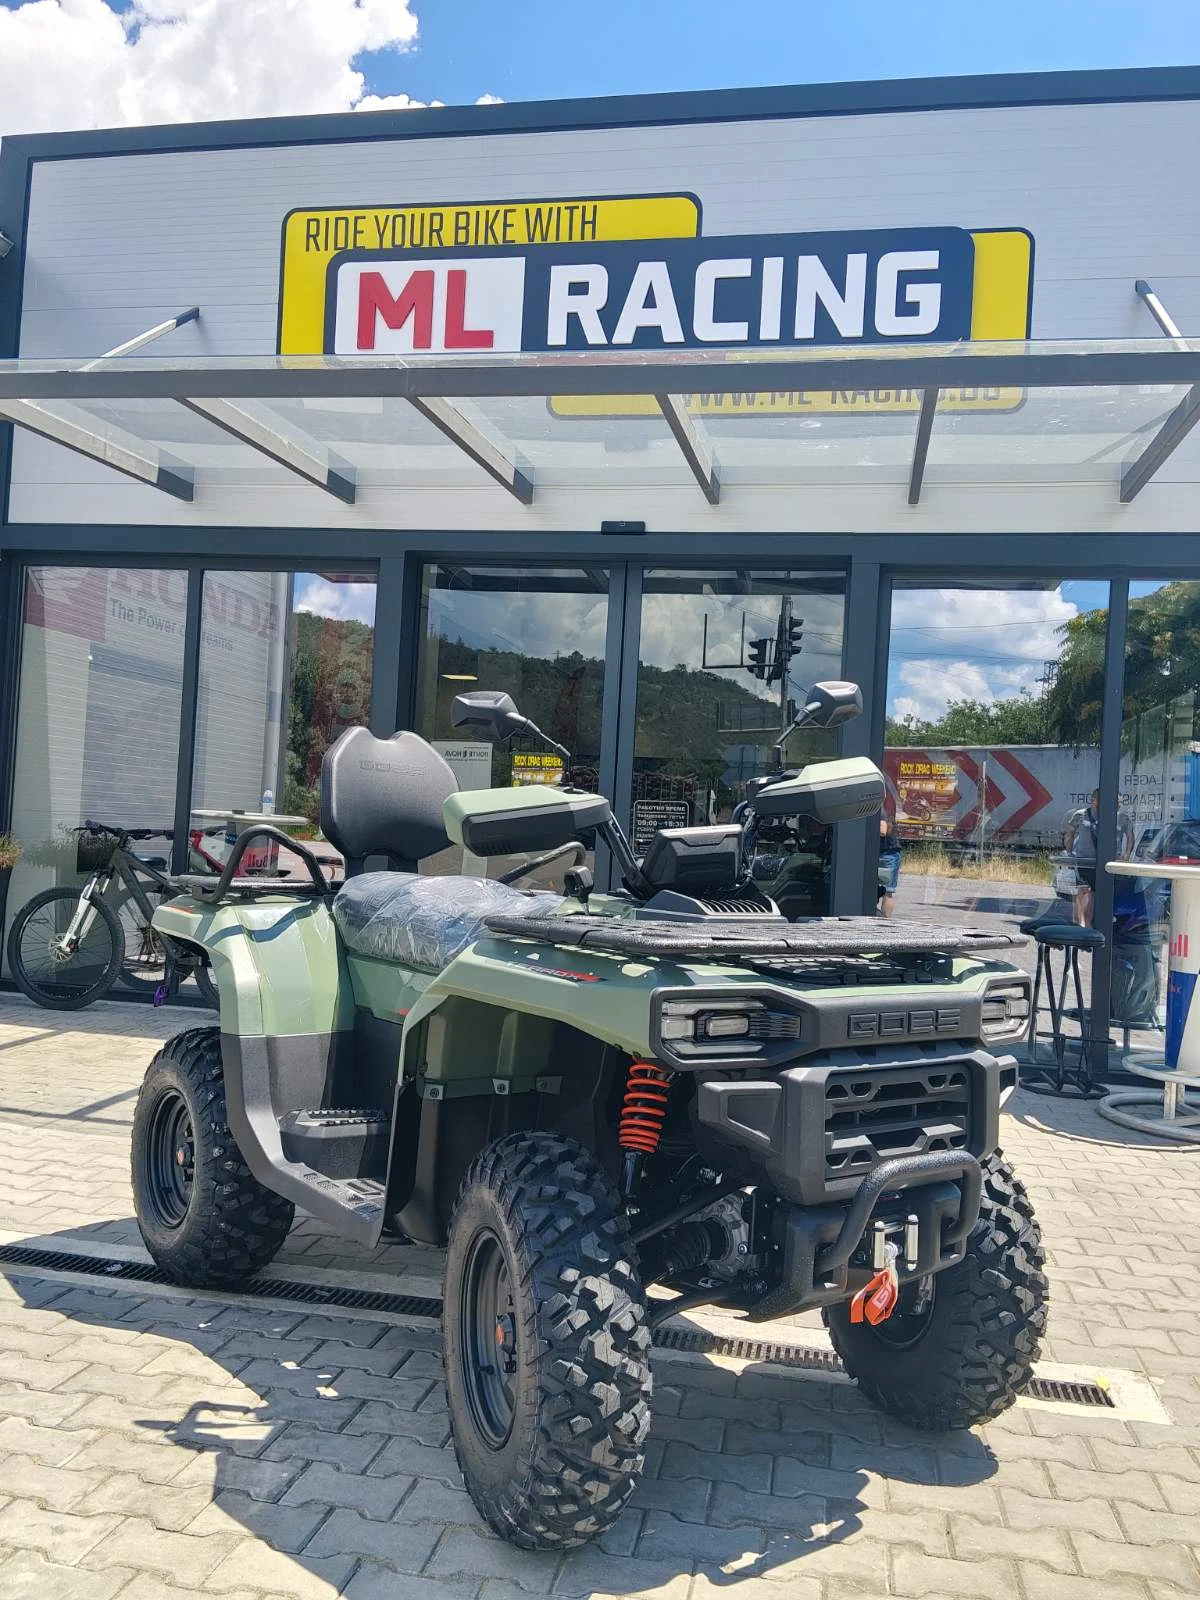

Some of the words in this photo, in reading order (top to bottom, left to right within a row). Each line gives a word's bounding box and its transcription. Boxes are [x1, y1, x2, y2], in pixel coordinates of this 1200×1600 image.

[305, 215, 367, 252] RIDE
[374, 212, 444, 250] YOUR
[454, 208, 517, 247] BIKE
[525, 200, 598, 243] WITH
[356, 268, 494, 350] ML
[546, 249, 943, 347] RACING
[109, 598, 135, 622] The
